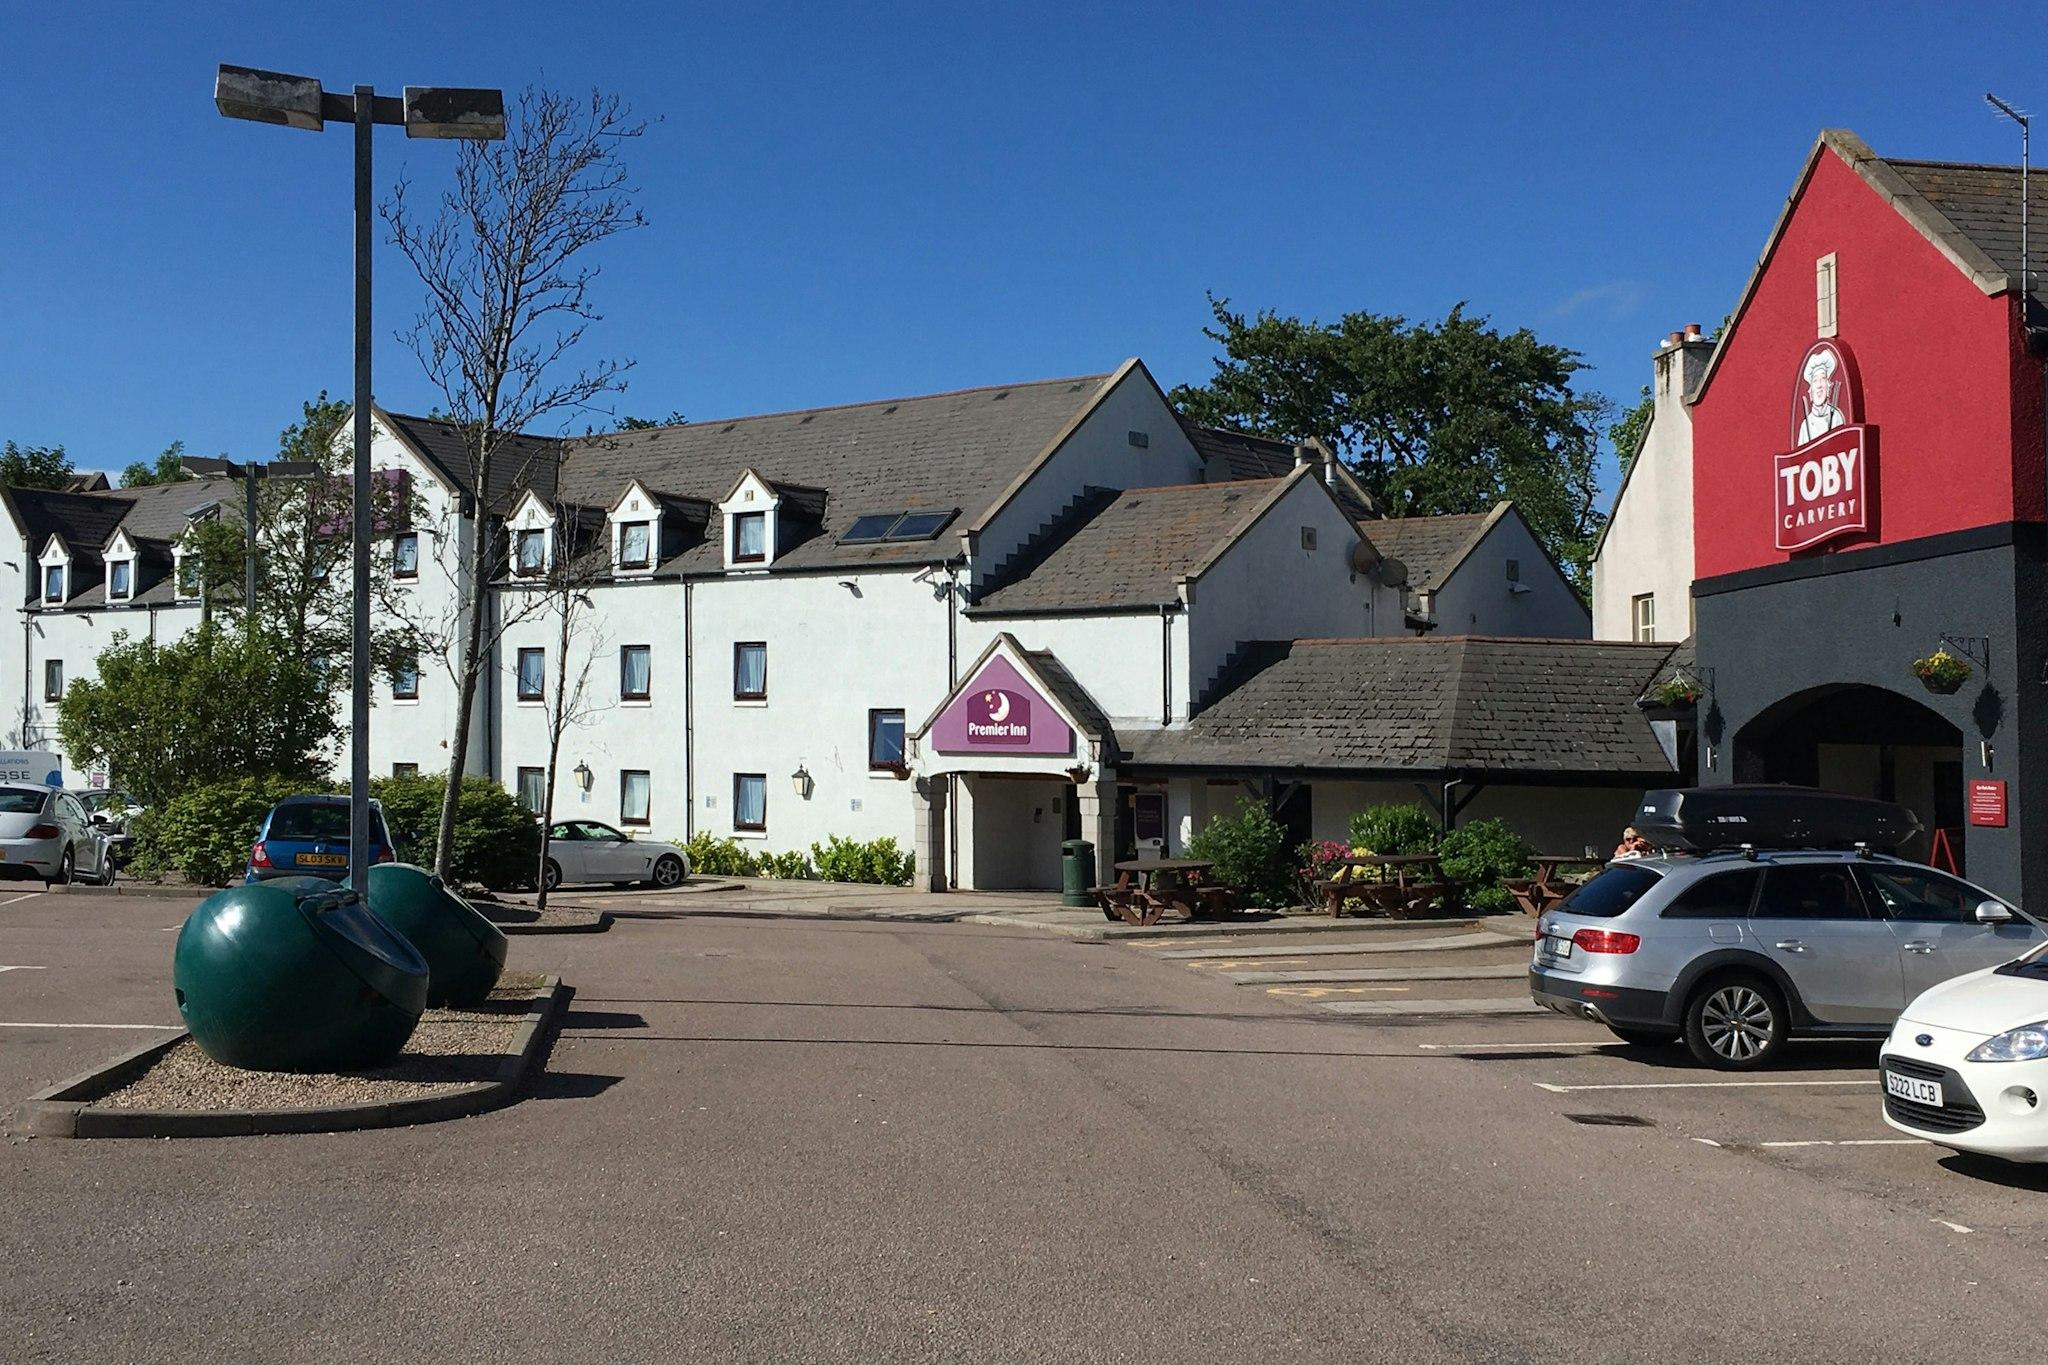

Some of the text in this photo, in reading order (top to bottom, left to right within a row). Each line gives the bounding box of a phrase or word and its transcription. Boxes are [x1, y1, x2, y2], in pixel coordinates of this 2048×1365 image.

[1780, 448, 1858, 506] TOBY
[1784, 498, 1856, 529] CARVERY
[968, 722, 1027, 736] Premier Inn
[299, 854, 323, 864] SL03
[1889, 1074, 1936, 1102] S222 LCB
